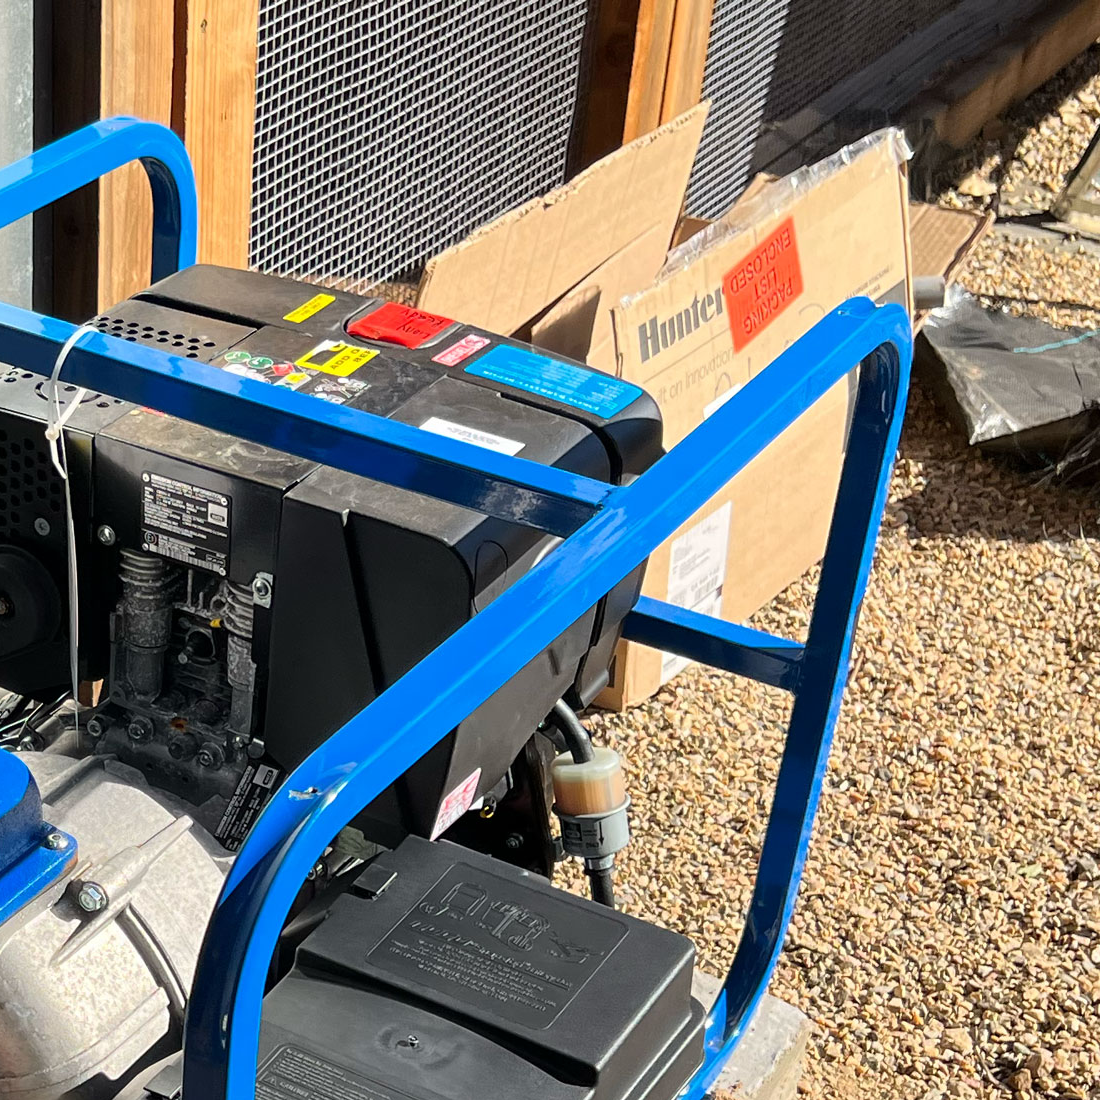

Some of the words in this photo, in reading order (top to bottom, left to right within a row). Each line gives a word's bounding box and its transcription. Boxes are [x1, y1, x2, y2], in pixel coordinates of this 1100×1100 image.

[730, 227, 792, 294] ENCLOSED
[754, 266, 777, 301] LIST
[638, 286, 724, 364] Hunter
[743, 277, 793, 335] PACKING
[331, 356, 351, 370] ADD
[670, 378, 682, 398] on
[685, 347, 735, 389] Innovation
